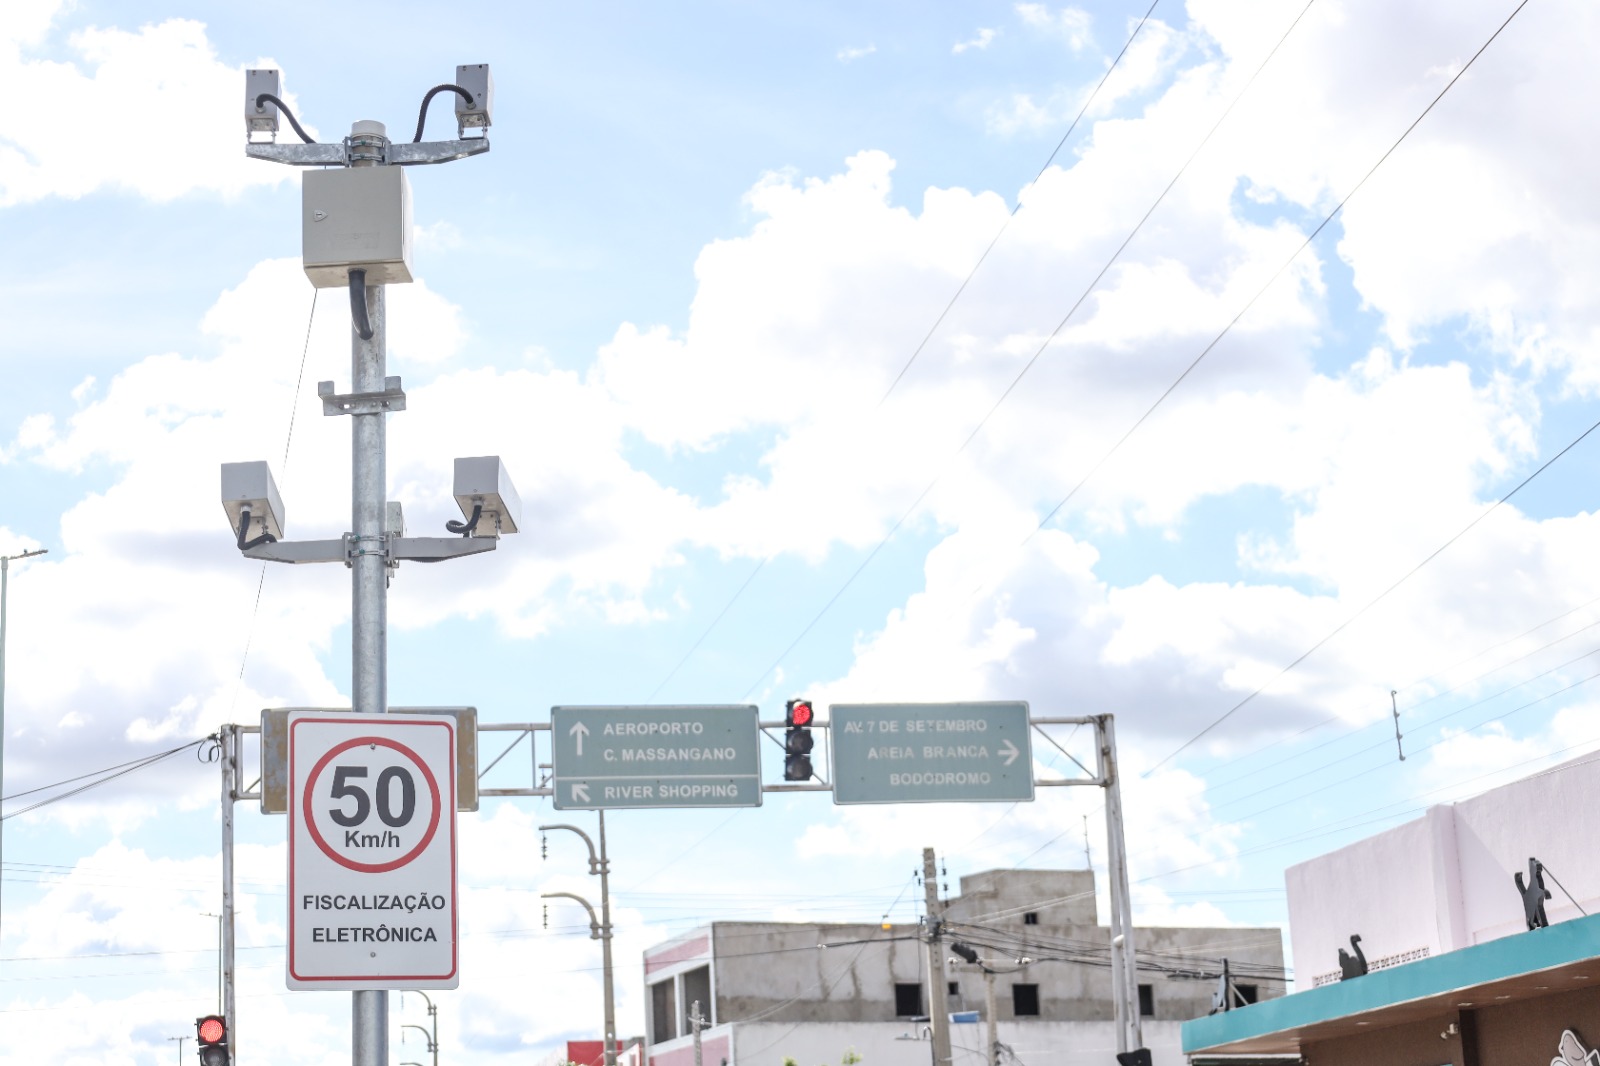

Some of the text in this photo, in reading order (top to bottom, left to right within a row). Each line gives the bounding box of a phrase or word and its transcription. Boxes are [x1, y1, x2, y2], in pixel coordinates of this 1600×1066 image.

[603, 722, 704, 736] AEROPORTO
[867, 720, 875, 733] 7
[879, 720, 898, 732] DE
[906, 719, 988, 732] SETEMBRO
[603, 747, 736, 762] C. MASSANGANO
[868, 745, 989, 760] AREIA BRANCA
[328, 765, 416, 828] 50
[604, 784, 738, 799] RIVER SHOPPING
[345, 830, 400, 848] Km/h
[303, 892, 446, 914] FISCALIZAÇÃO
[312, 923, 438, 943] ELETRÔNICA
